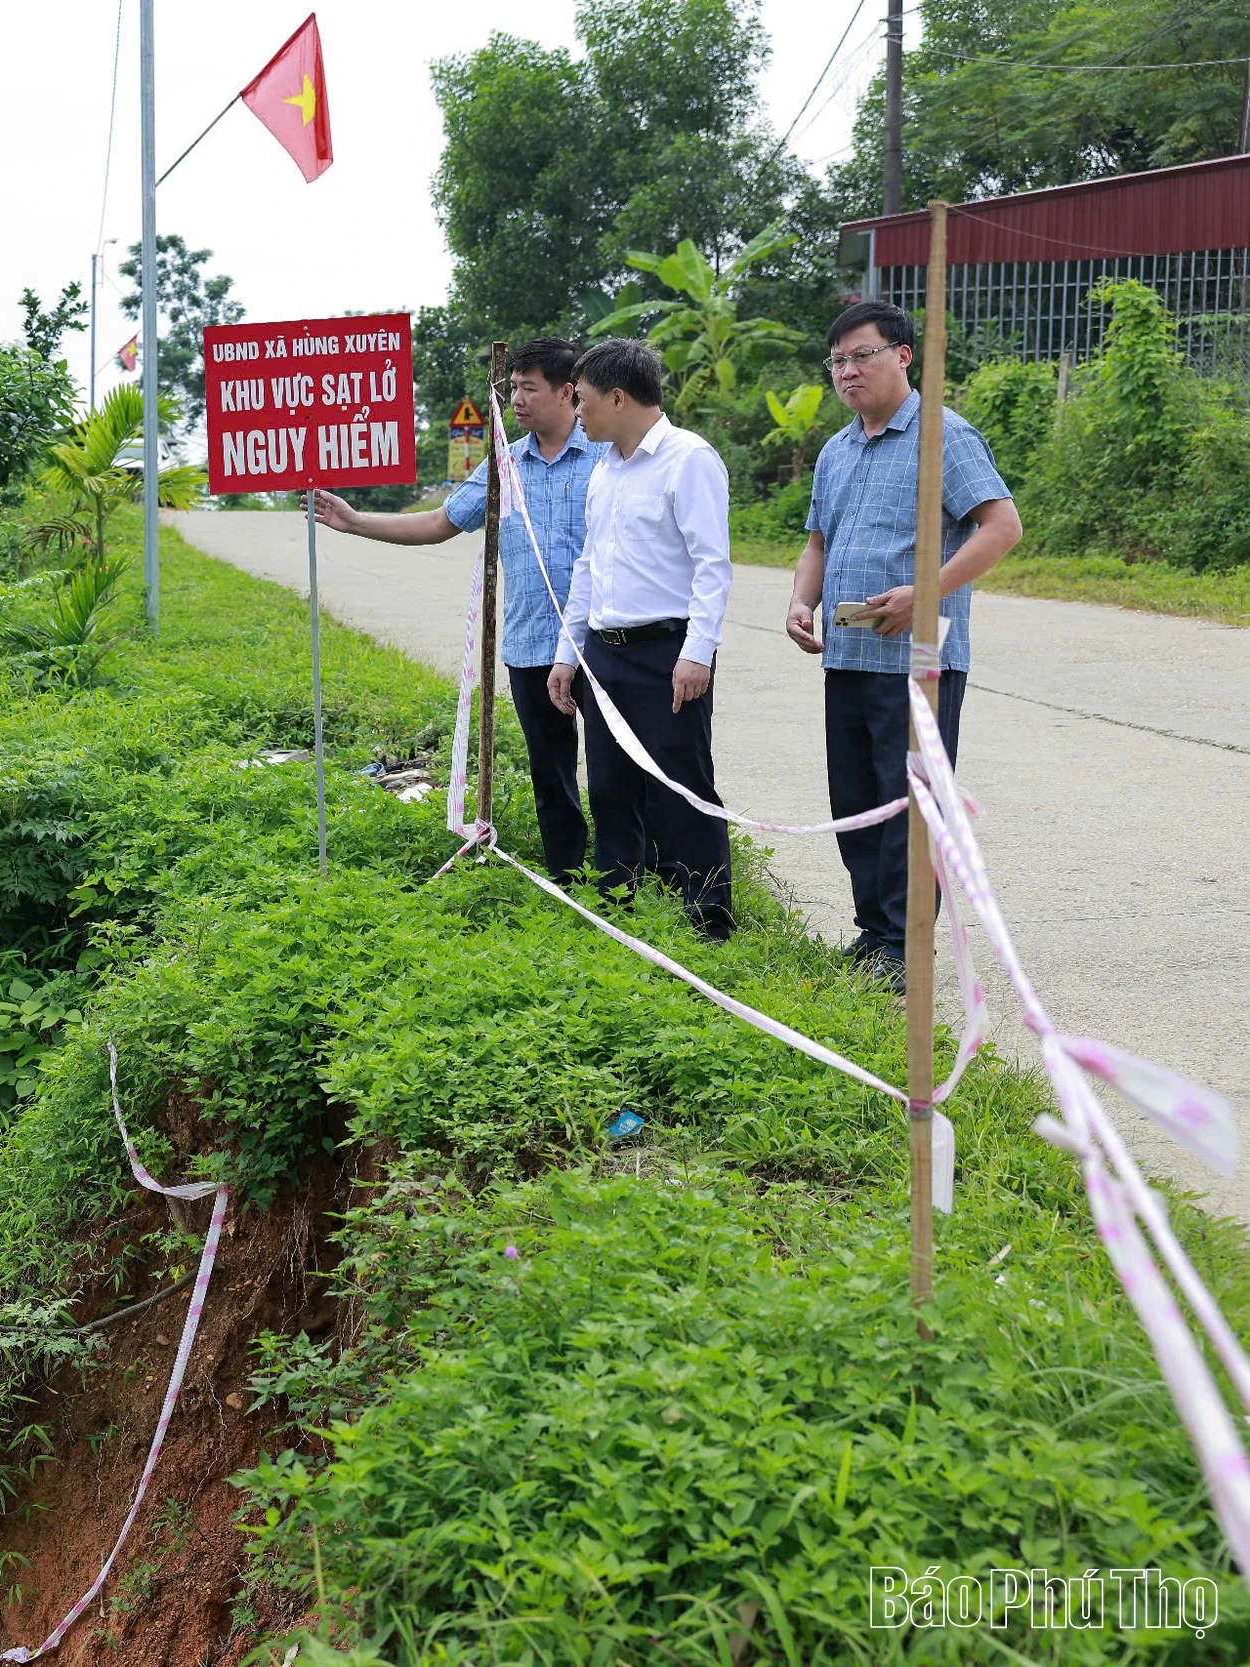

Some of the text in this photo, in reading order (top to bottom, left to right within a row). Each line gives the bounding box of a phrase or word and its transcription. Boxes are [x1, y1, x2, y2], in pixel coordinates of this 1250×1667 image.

[213, 329, 400, 362] UBND XÃ HÙNG XUYÊN
[220, 359, 397, 415] KHU VỰC SẠT LỞ
[222, 405, 399, 476] NGUY HIỂM
